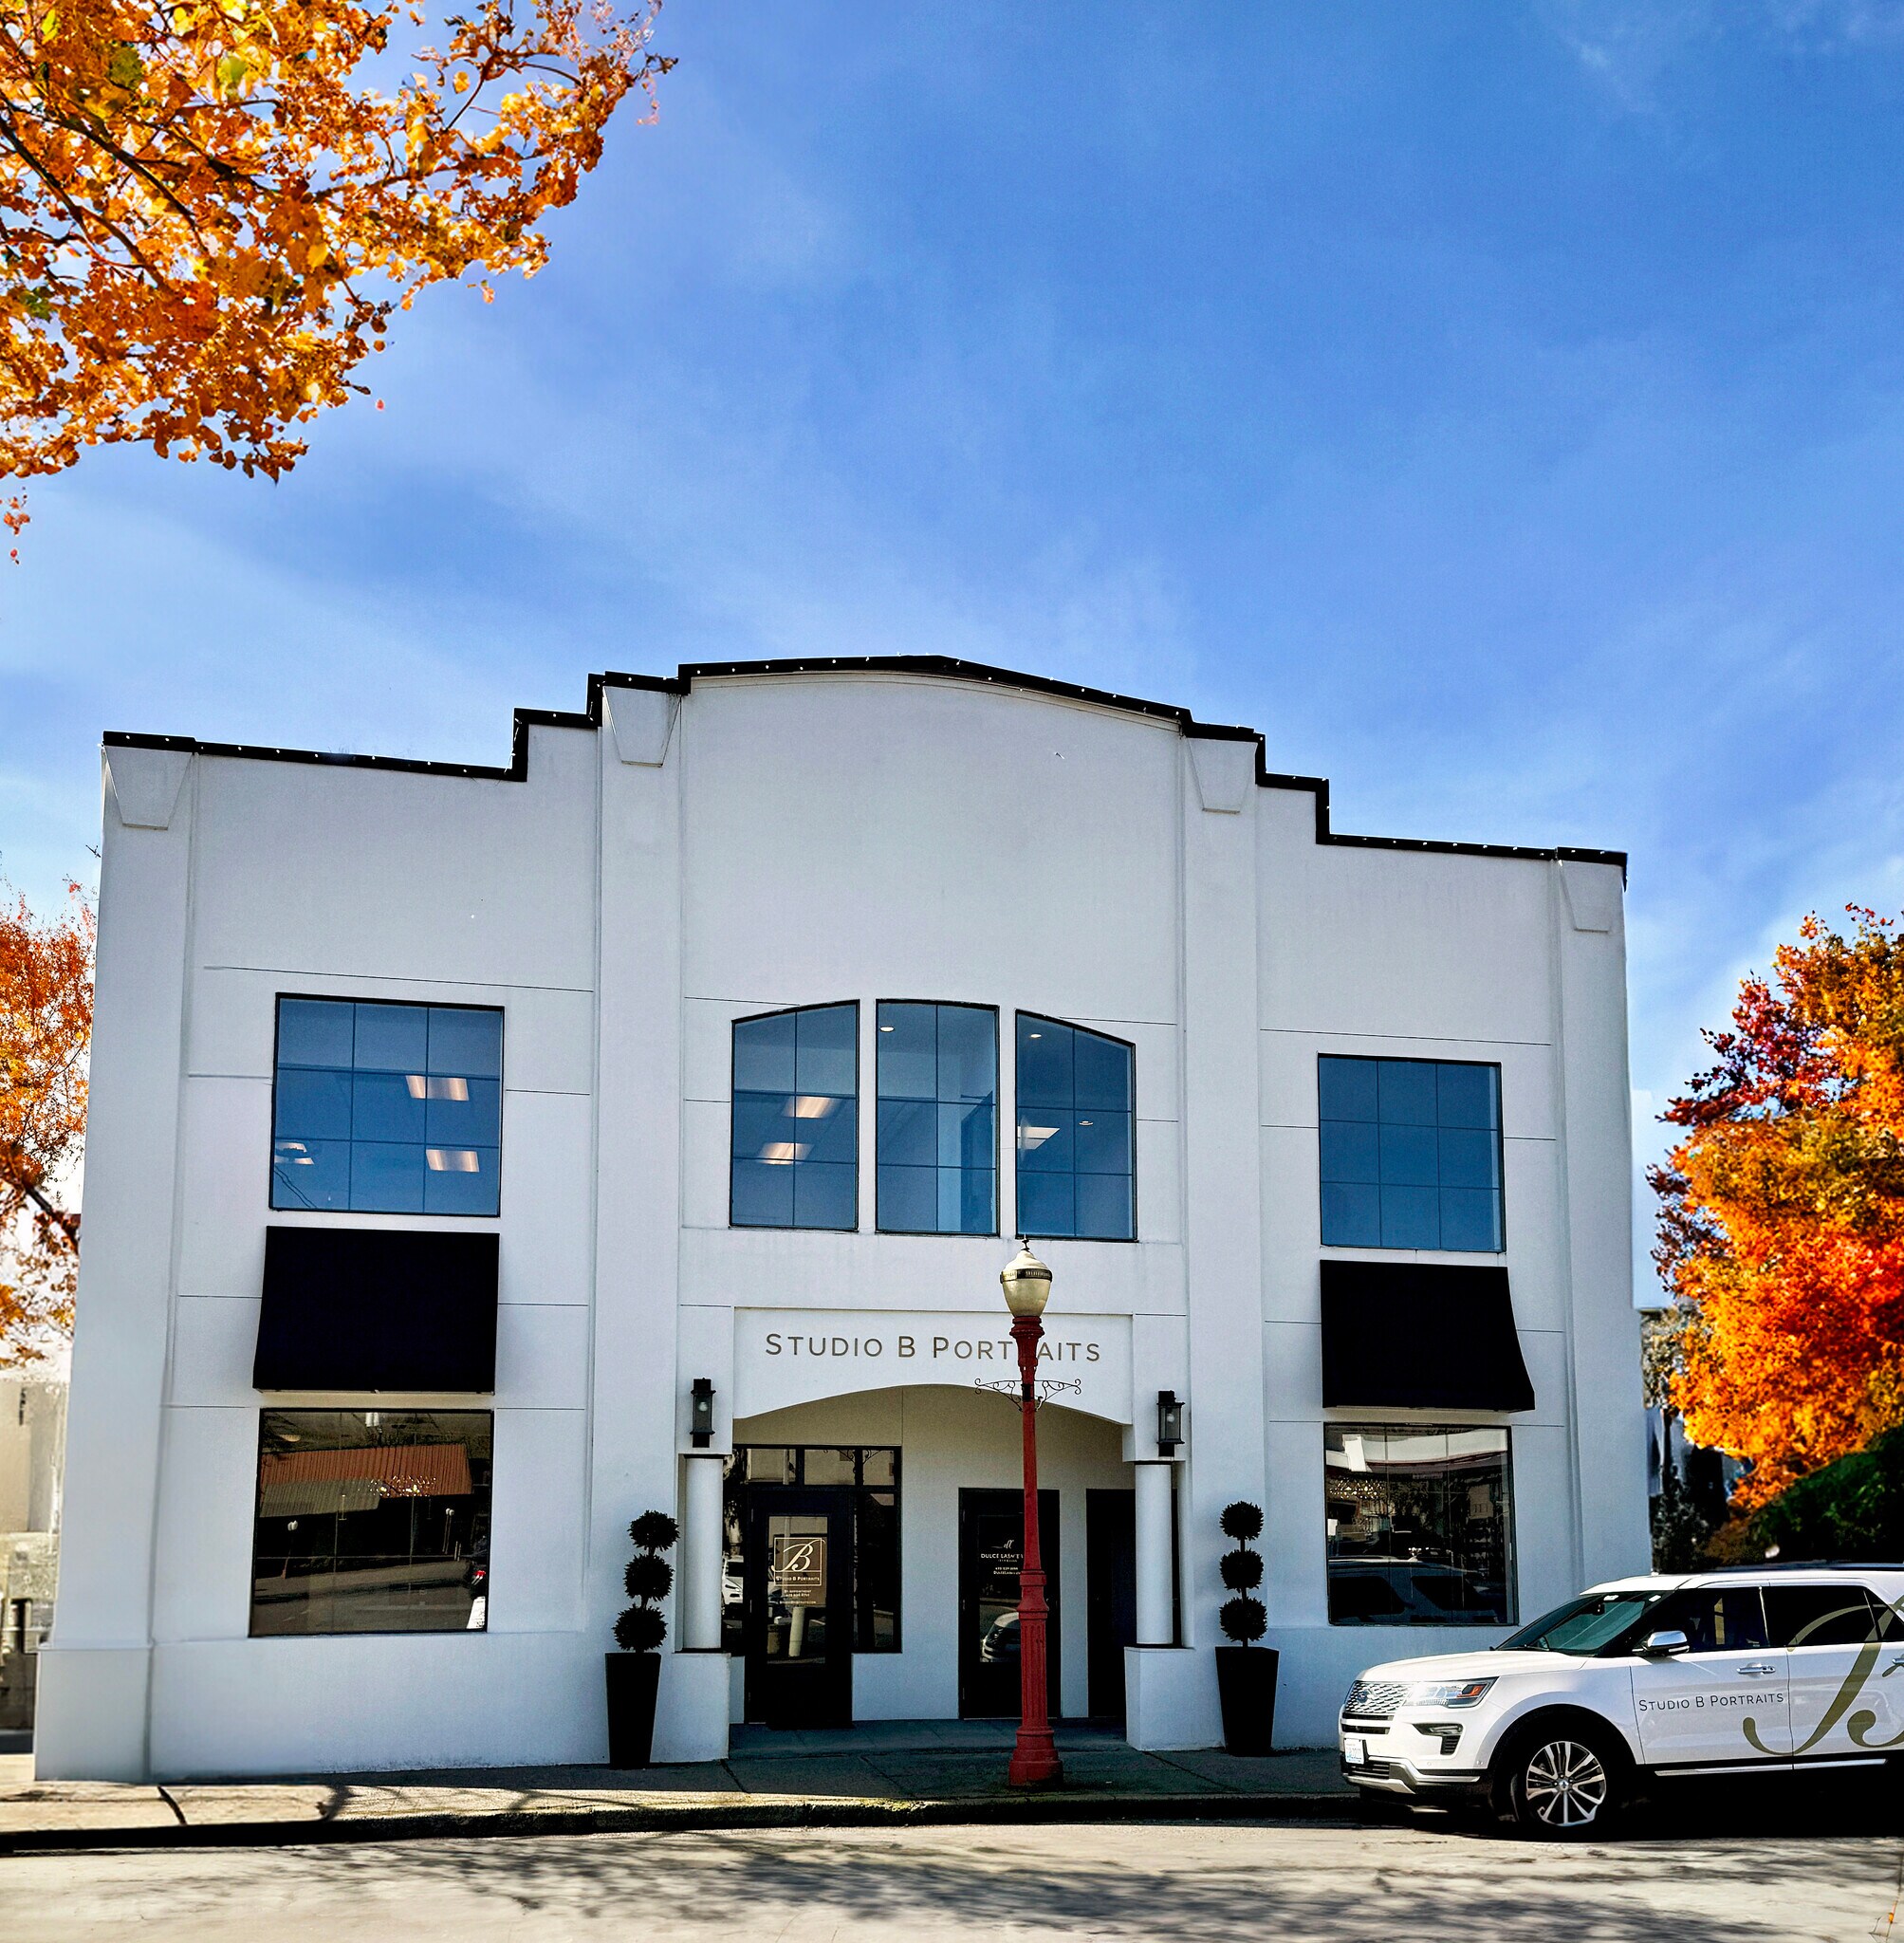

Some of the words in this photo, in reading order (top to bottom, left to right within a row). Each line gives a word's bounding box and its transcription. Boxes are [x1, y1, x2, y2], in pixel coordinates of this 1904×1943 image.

[765, 1333, 883, 1358] STUDIO
[897, 1336, 915, 1358] B
[933, 1336, 1100, 1362] PORTAITS
[1638, 1699, 1691, 1712] STUDIO
[1695, 1695, 1705, 1708] B
[1710, 1693, 1784, 1707] PORTRAITS
